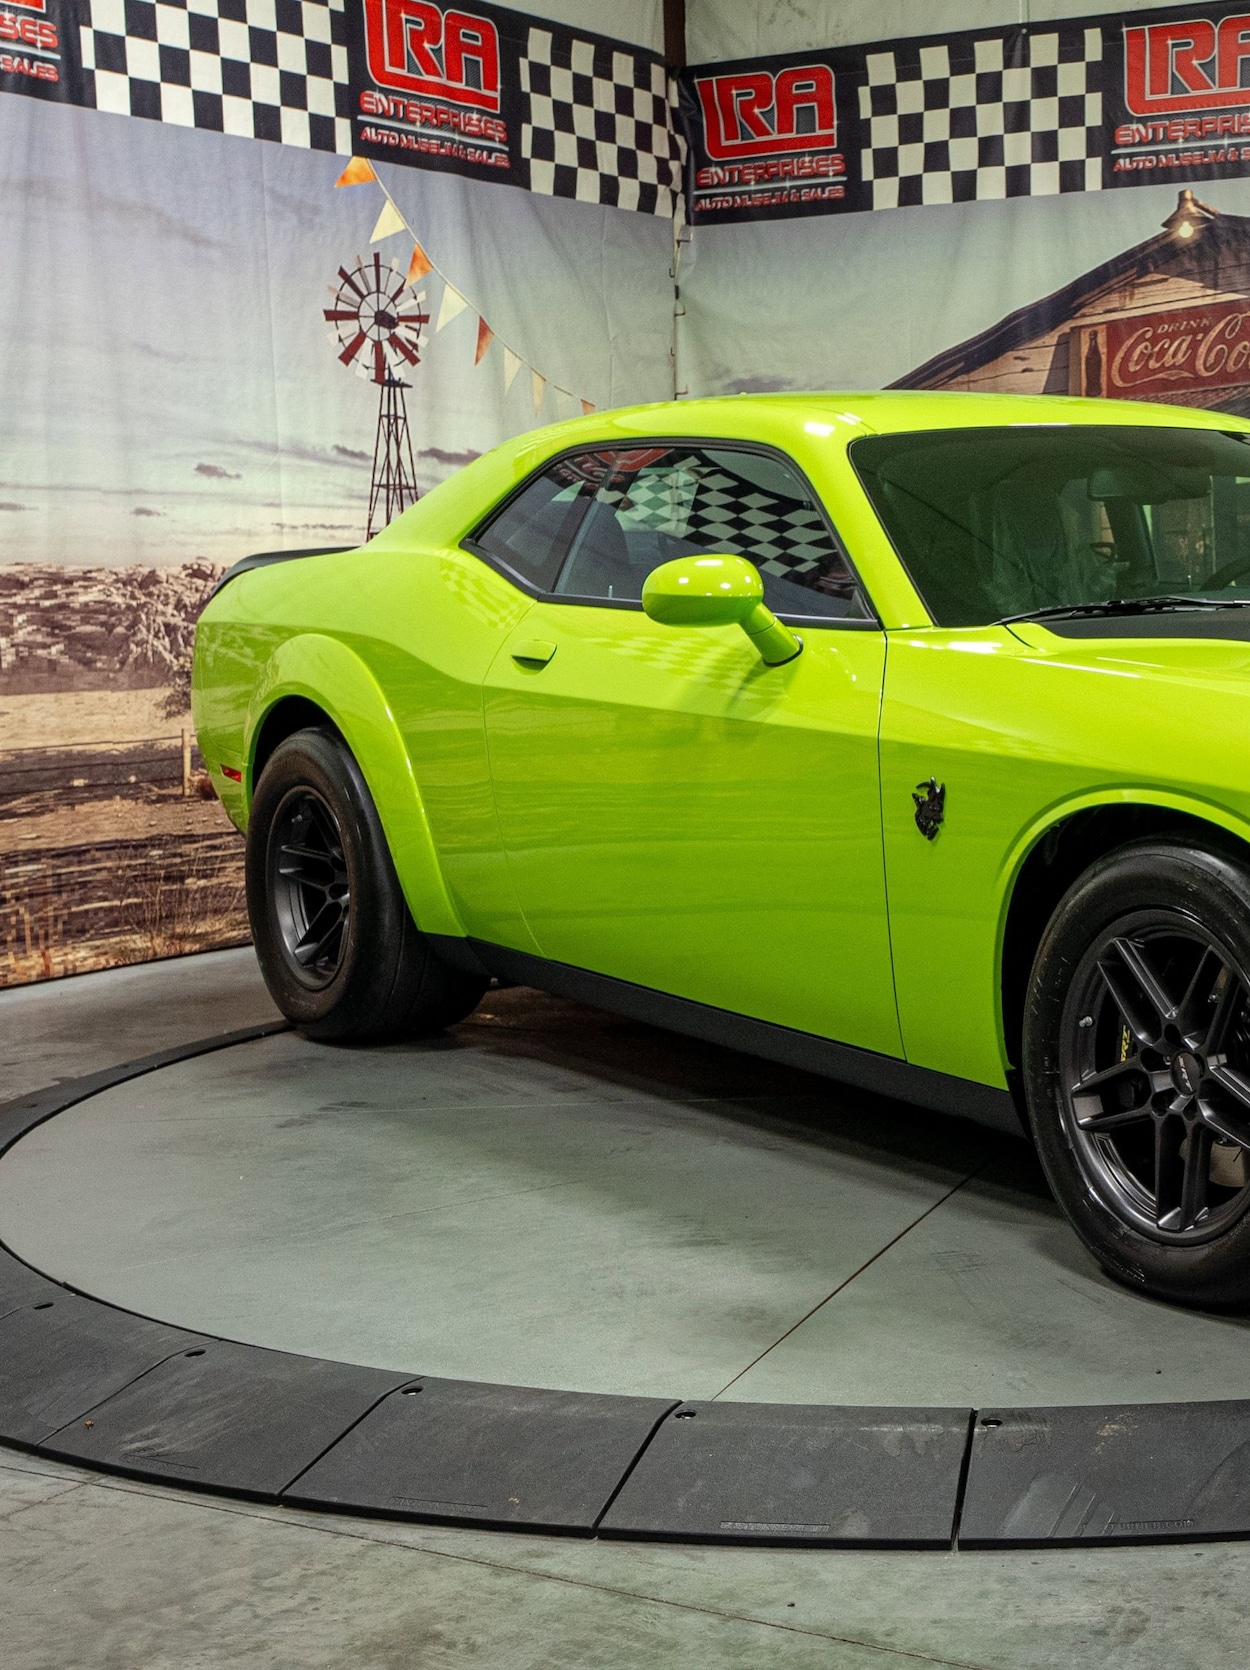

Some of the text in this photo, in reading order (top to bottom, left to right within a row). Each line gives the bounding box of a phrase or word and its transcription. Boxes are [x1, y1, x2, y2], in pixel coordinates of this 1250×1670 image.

[0, 54, 59, 82] SALES
[359, 90, 508, 142] ENTERPRISES
[360, 126, 399, 146] AUTO
[400, 133, 455, 157] MUSEUM
[467, 148, 510, 168] SALES
[1113, 155, 1157, 172] AUTO
[1158, 149, 1226, 168] MUSEUM
[1227, 148, 1239, 161] &
[696, 154, 846, 187] ENTERPRISES
[694, 195, 733, 211] AUTO
[734, 190, 788, 208] MUSEUM
[801, 185, 846, 201] SALES
